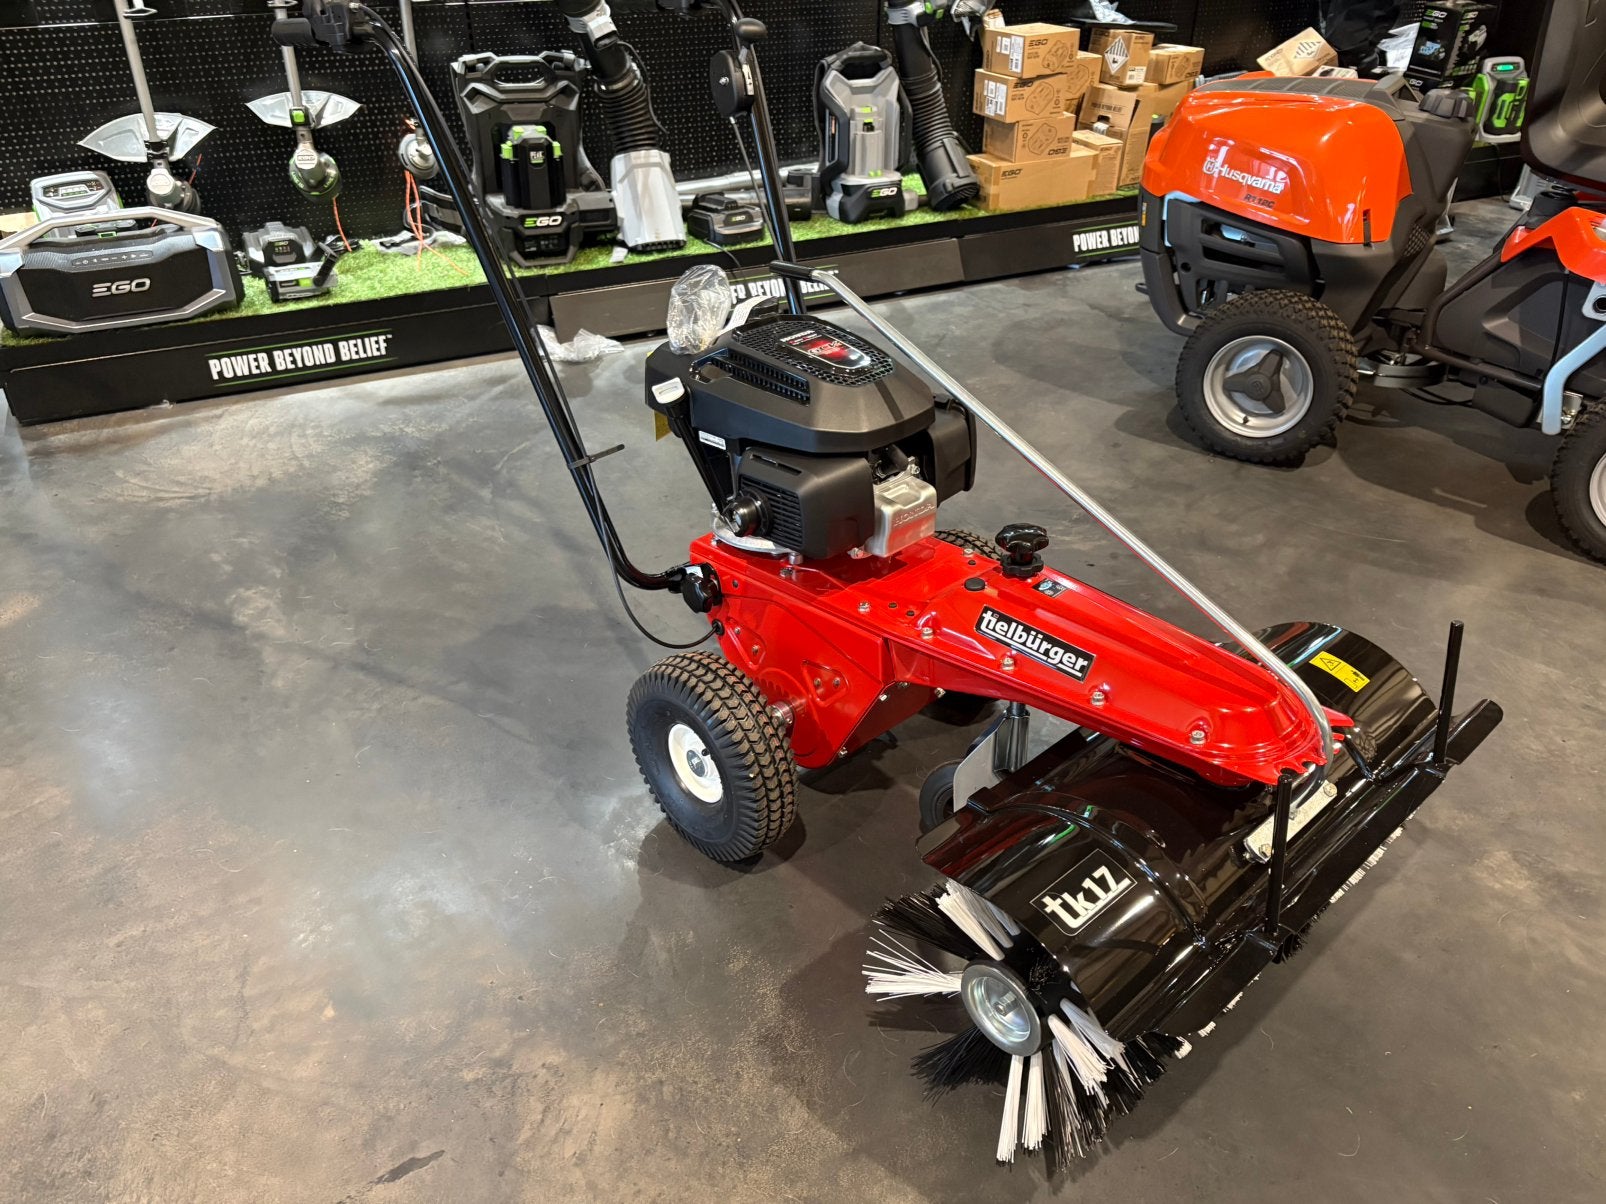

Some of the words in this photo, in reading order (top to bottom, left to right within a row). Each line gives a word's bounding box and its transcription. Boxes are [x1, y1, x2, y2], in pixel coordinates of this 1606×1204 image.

[1027, 39, 1048, 47] EGO
[1013, 81, 1033, 89] EGO
[1001, 169, 1022, 177] EGO
[1217, 164, 1286, 195] Husqvarna
[871, 187, 898, 198] EGO
[524, 215, 562, 227] EGO
[1072, 230, 1110, 252] POWER
[1109, 225, 1140, 247] BEYON
[92, 277, 151, 298] EGO
[208, 352, 272, 380] POWER
[273, 343, 336, 371] BEYOND
[980, 610, 1089, 675] tielbürger
[1041, 865, 1131, 928] tk17
